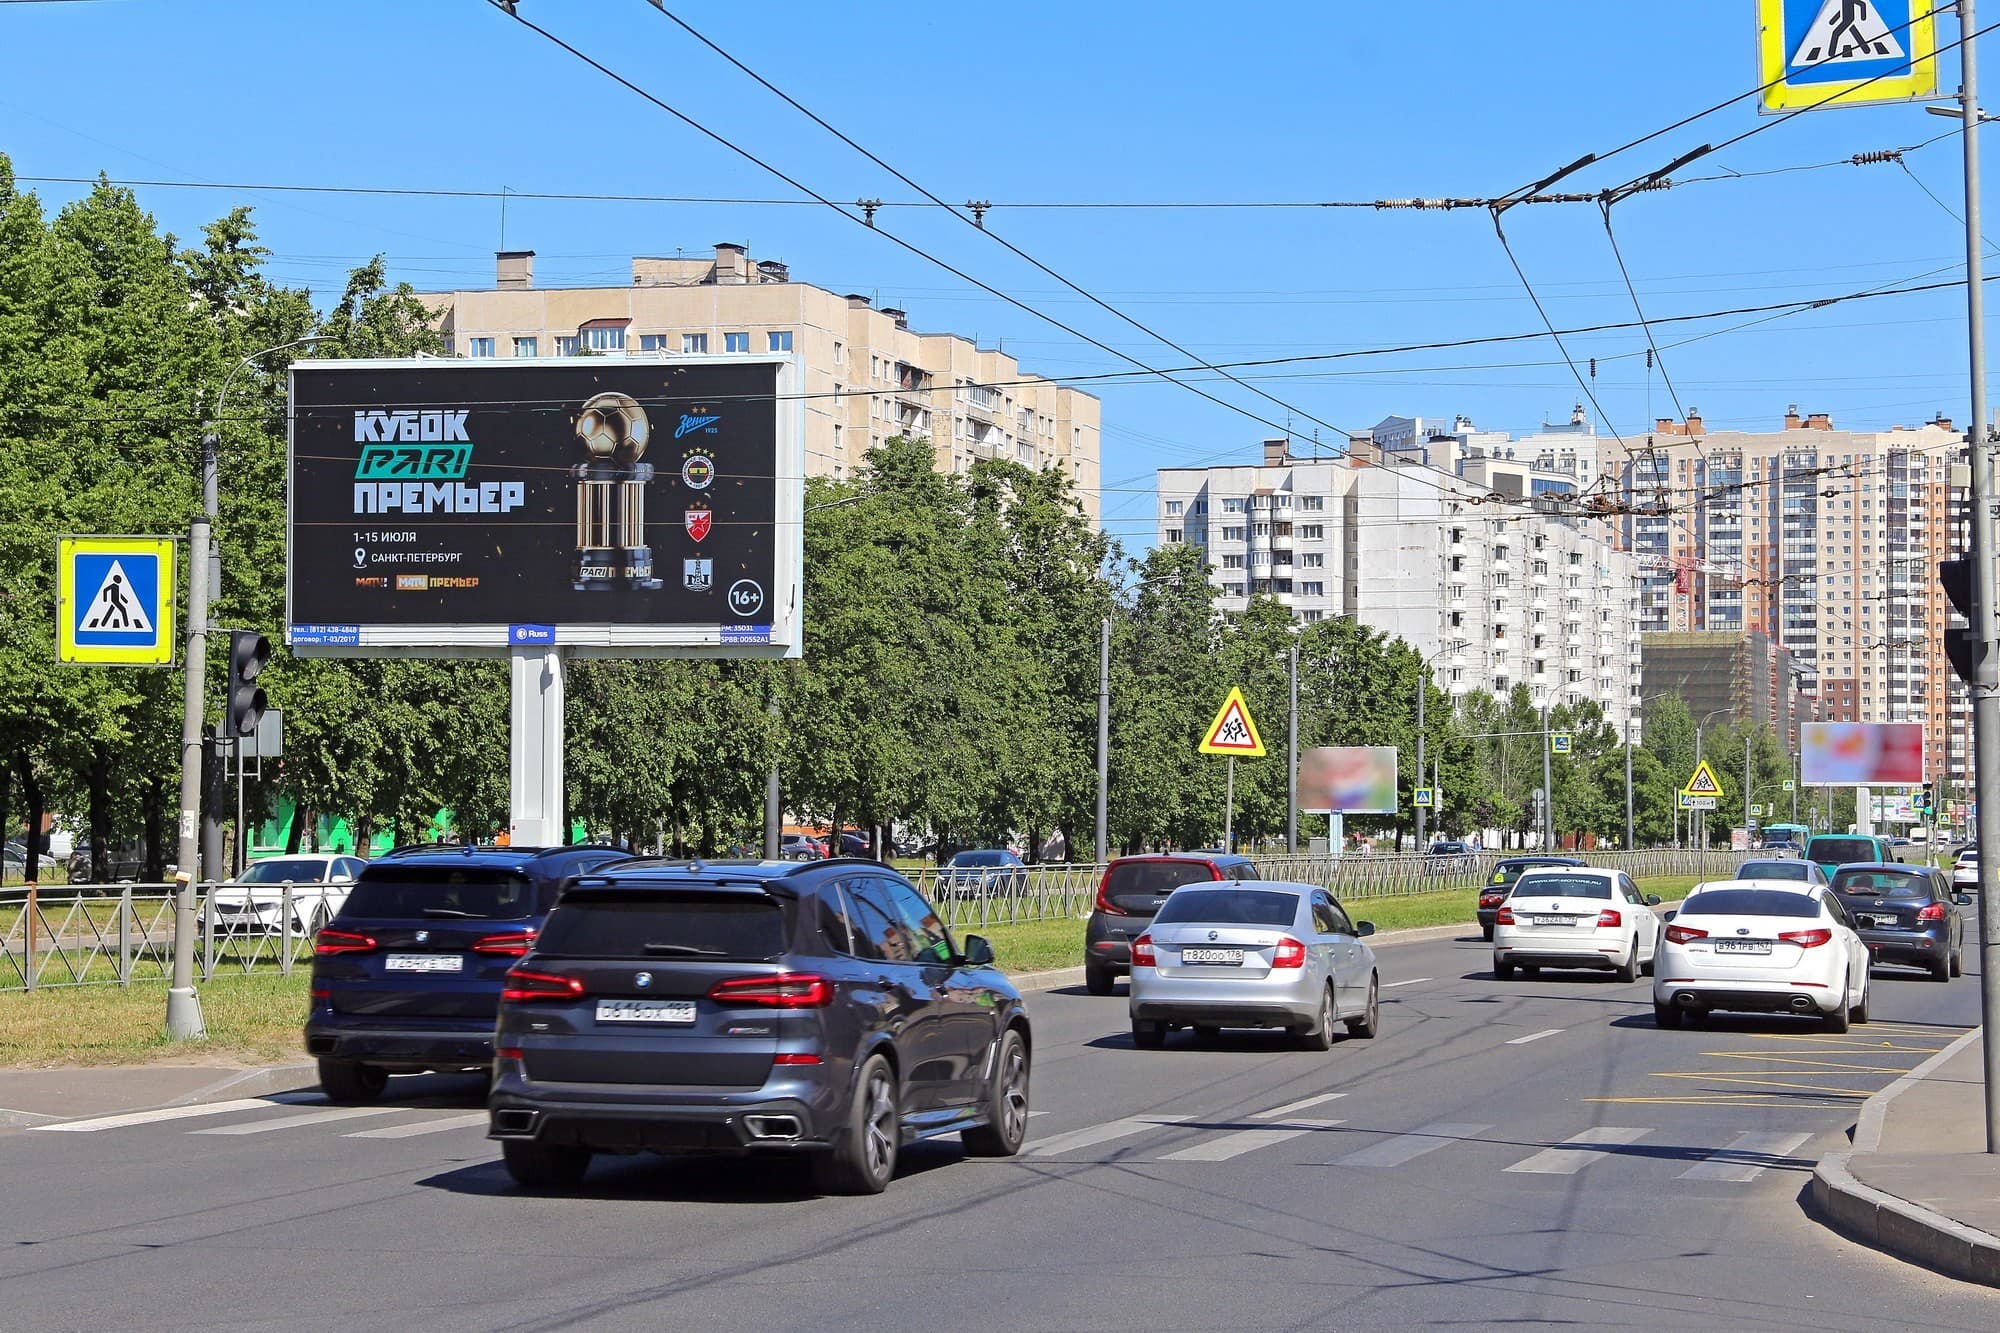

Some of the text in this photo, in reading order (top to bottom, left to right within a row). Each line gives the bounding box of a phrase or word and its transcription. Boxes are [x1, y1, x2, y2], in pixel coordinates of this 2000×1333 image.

[354, 410, 470, 442] КУБОК
[361, 448, 467, 475] PARI
[353, 481, 525, 513] ПРЕМЬЕР
[353, 531, 417, 543] 1-15 ИЮЛЯ
[371, 552, 463, 563] САНКТ-ПЕТЕРБУРГ
[580, 566, 607, 577] PARI
[429, 577, 479, 588] ПРЕМЬЕР
[733, 590, 759, 605] 16+
[528, 630, 548, 638] Russ
[1186, 950, 1224, 960] Т820ОО
